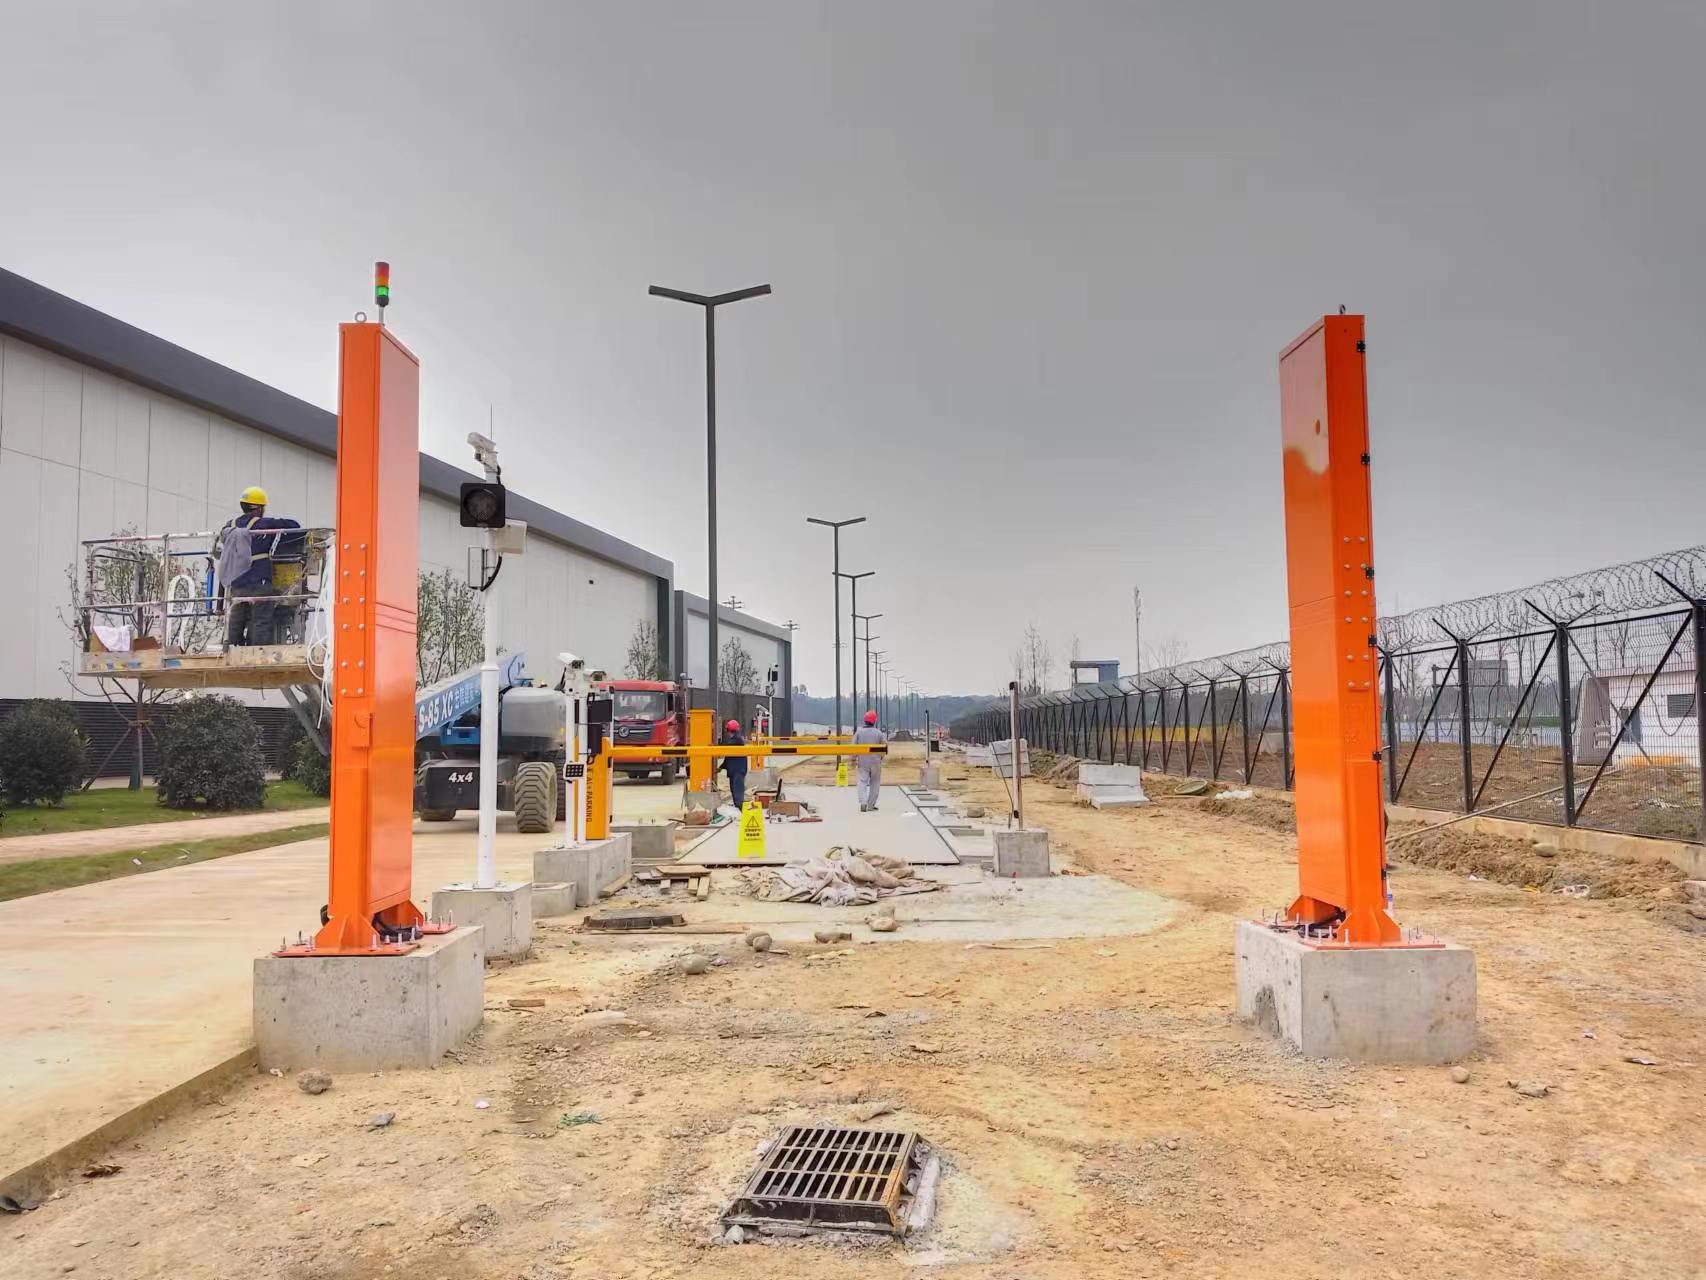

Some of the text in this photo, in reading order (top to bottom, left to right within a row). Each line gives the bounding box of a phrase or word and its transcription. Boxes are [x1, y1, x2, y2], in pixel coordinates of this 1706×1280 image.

[418, 697, 440, 733] S-85
[441, 690, 454, 721] XC
[448, 771, 474, 783] 4x4
